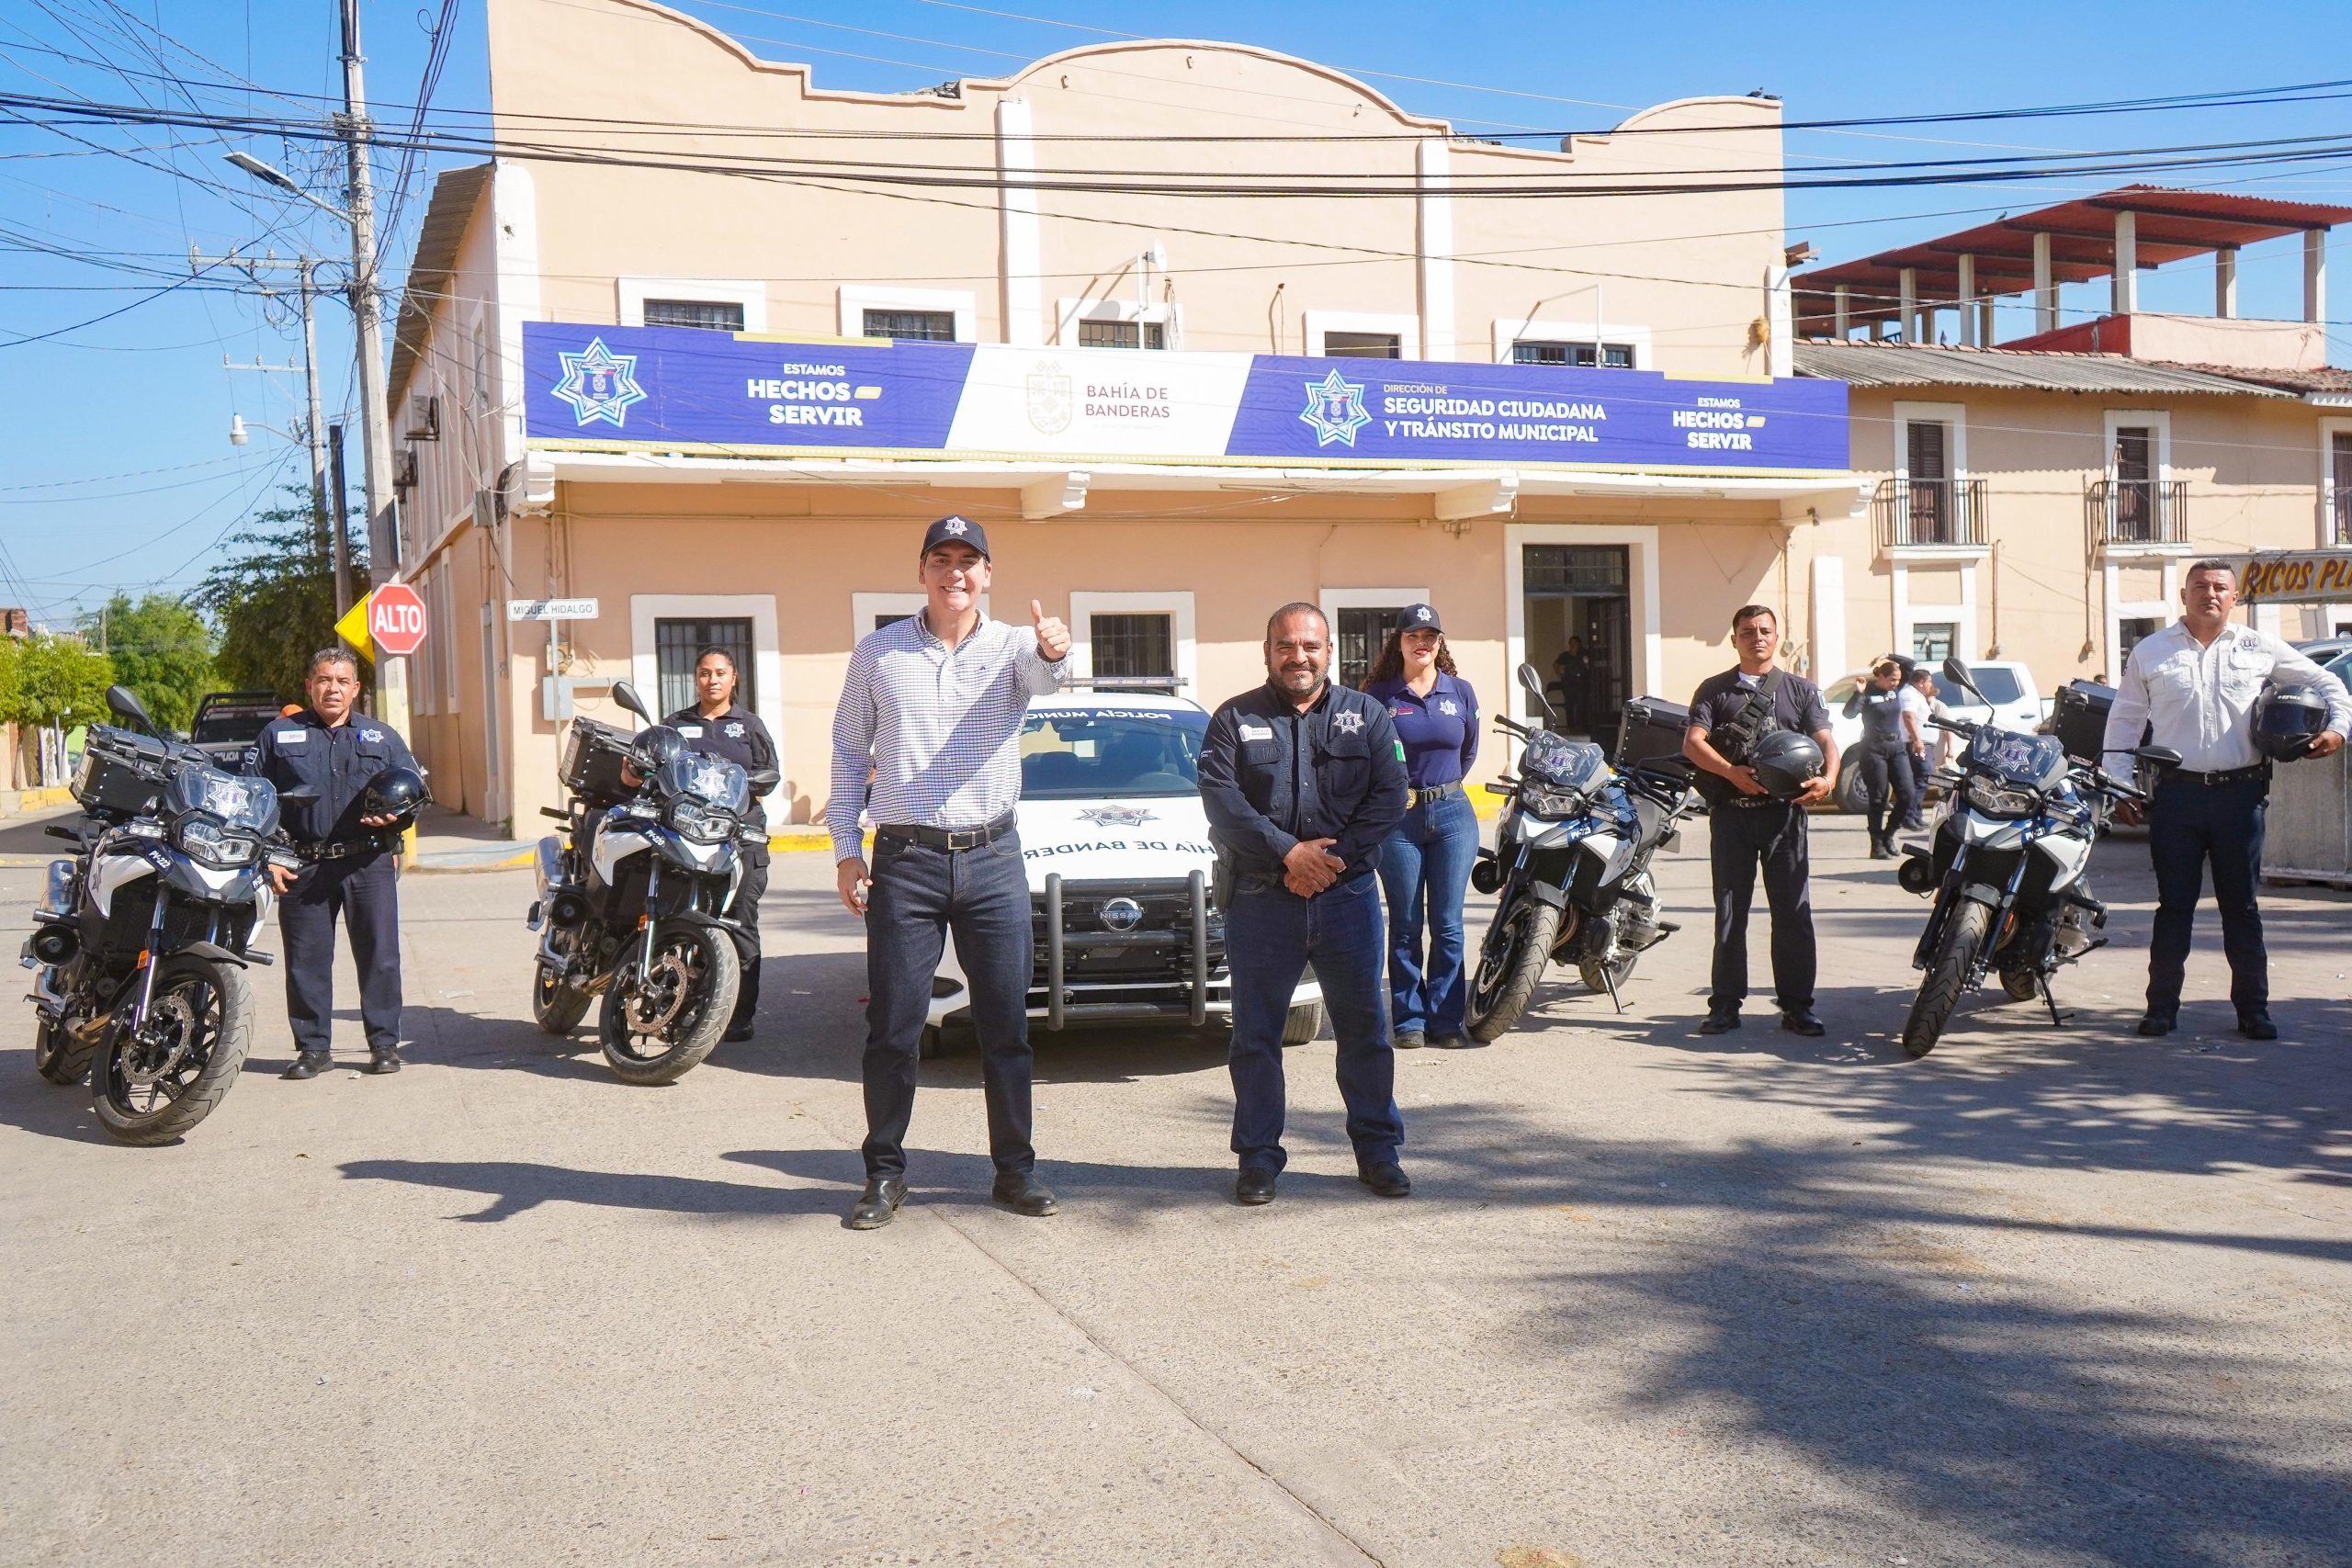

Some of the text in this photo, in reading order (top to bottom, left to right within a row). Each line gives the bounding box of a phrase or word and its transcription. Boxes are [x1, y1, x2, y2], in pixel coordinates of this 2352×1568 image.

[783, 363, 846, 377] ESTAMOS
[747, 378, 851, 401] HECHOS
[1086, 382, 1169, 400] BAHÍA DE
[1383, 383, 1448, 395] DIRECCIÓN DE
[1085, 403, 1170, 418] BANDERAS
[1384, 397, 1607, 421] SEGURIDAD CIUDADANA
[1697, 397, 1741, 409] ESTAMOS
[769, 404, 863, 426] SERVIR
[1672, 411, 1745, 430] HECHOS
[1384, 416, 1600, 443] Y TRÁNSITO MUNICIPAL
[1687, 432, 1753, 450] SERVIR
[2240, 560, 2313, 594] RICOS
[514, 604, 593, 615] MIGUEL HIDALGO
[374, 604, 422, 634] ALTO
[1099, 911, 1143, 919] NISSAN
